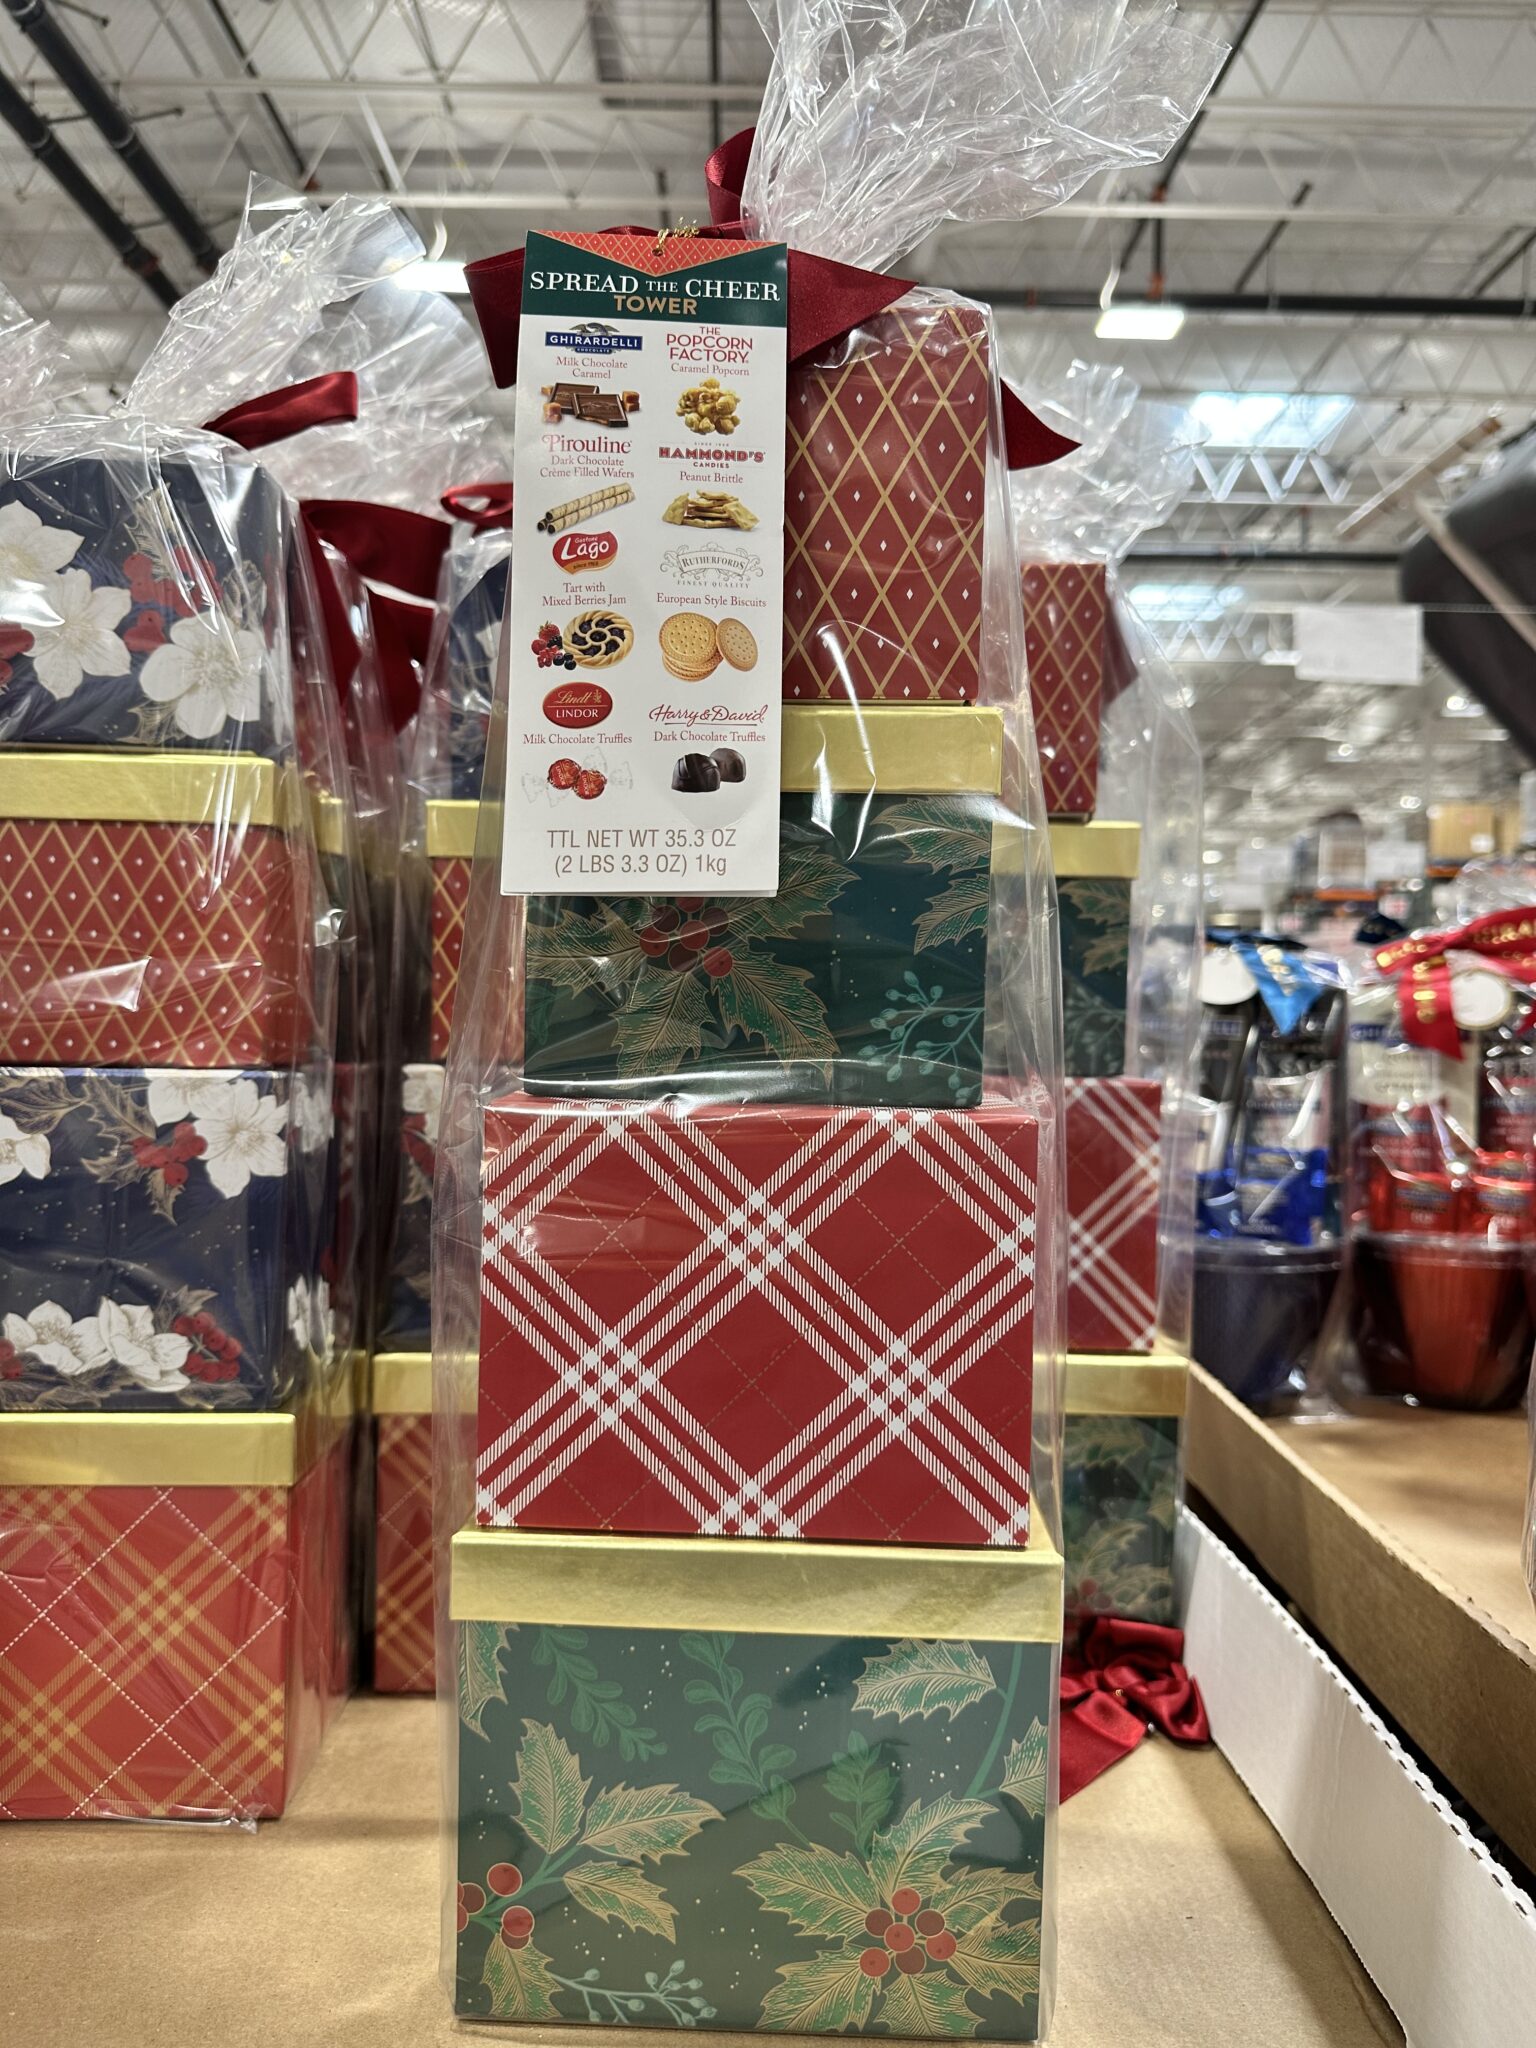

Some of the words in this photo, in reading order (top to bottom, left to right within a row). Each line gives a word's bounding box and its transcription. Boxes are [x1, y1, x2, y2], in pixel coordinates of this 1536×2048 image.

[530, 272, 638, 293] SPREAD
[646, 280, 678, 292] THE
[685, 279, 780, 301] CHEER
[614, 295, 697, 315] TOWER
[700, 327, 721, 335] THE
[550, 335, 638, 347] GHIRARDELLI
[667, 334, 753, 350] POPCORN
[670, 347, 749, 363] FACTORY
[556, 356, 579, 367] Milk
[582, 358, 628, 369] Chocolate
[573, 369, 611, 379] Caramel
[671, 363, 709, 374] Caramel
[712, 365, 750, 377] Popcorn
[542, 434, 632, 454] Pirouline
[551, 455, 574, 465] Dark
[577, 455, 624, 466] Chocolate
[659, 447, 764, 463] HAMMOND'S
[693, 461, 730, 469] CANDIES
[574, 467, 599, 477] Filled
[602, 467, 635, 478] Wafers
[680, 471, 711, 482] Peanut
[714, 472, 743, 483] Brittle
[561, 537, 609, 560] Lago
[563, 582, 582, 593] Tart
[585, 581, 606, 592] with
[542, 595, 572, 606] Mixed
[574, 594, 606, 606] Berries
[608, 594, 627, 606] Jam
[657, 592, 701, 606] European
[704, 594, 728, 608] Style
[730, 595, 767, 607] Biscuits
[555, 690, 592, 704] Lindt
[556, 709, 599, 718] LINDOR
[523, 734, 546, 744] Milk
[549, 733, 595, 744] Chocolate
[597, 733, 633, 744] Truffles
[654, 731, 677, 741] Dark
[680, 730, 728, 741] Chocolate
[730, 731, 766, 742] Truffles
[547, 829, 580, 848] TTL
[587, 829, 623, 848] NET
[629, 829, 659, 847] WT
[665, 829, 704, 847] 35.3
[712, 829, 737, 847] OZ
[555, 855, 572, 877] (2
[579, 855, 614, 873] LBS
[621, 855, 649, 873] 3.3
[656, 854, 688, 877] OZ)
[695, 854, 727, 876] 1kg
